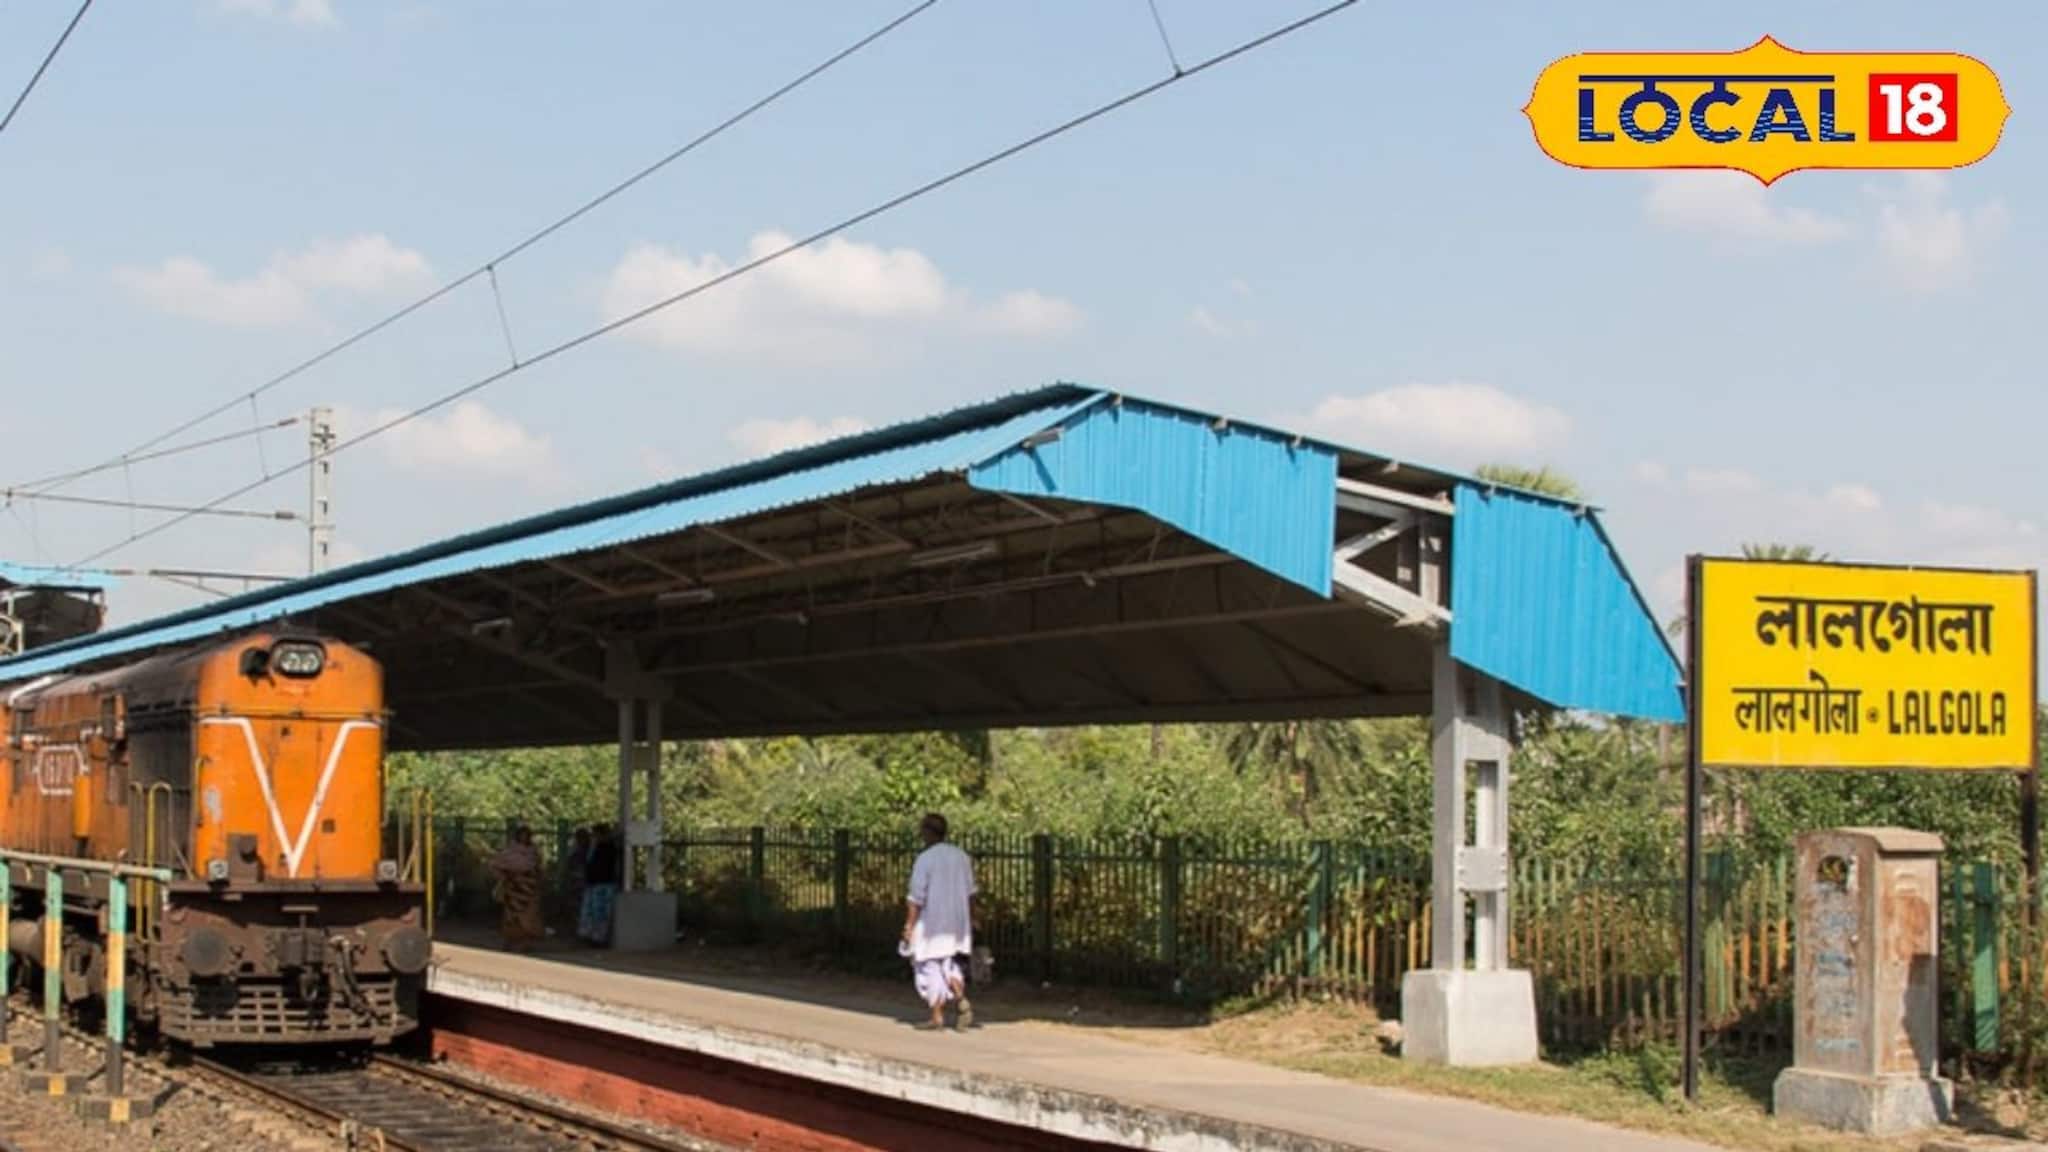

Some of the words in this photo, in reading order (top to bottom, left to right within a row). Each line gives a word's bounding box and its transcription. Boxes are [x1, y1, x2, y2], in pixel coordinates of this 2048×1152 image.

[1755, 596, 1994, 655] লালগোলা
[1732, 669, 1862, 734] लालगोला
[1888, 690, 2007, 735] LALGOLA
